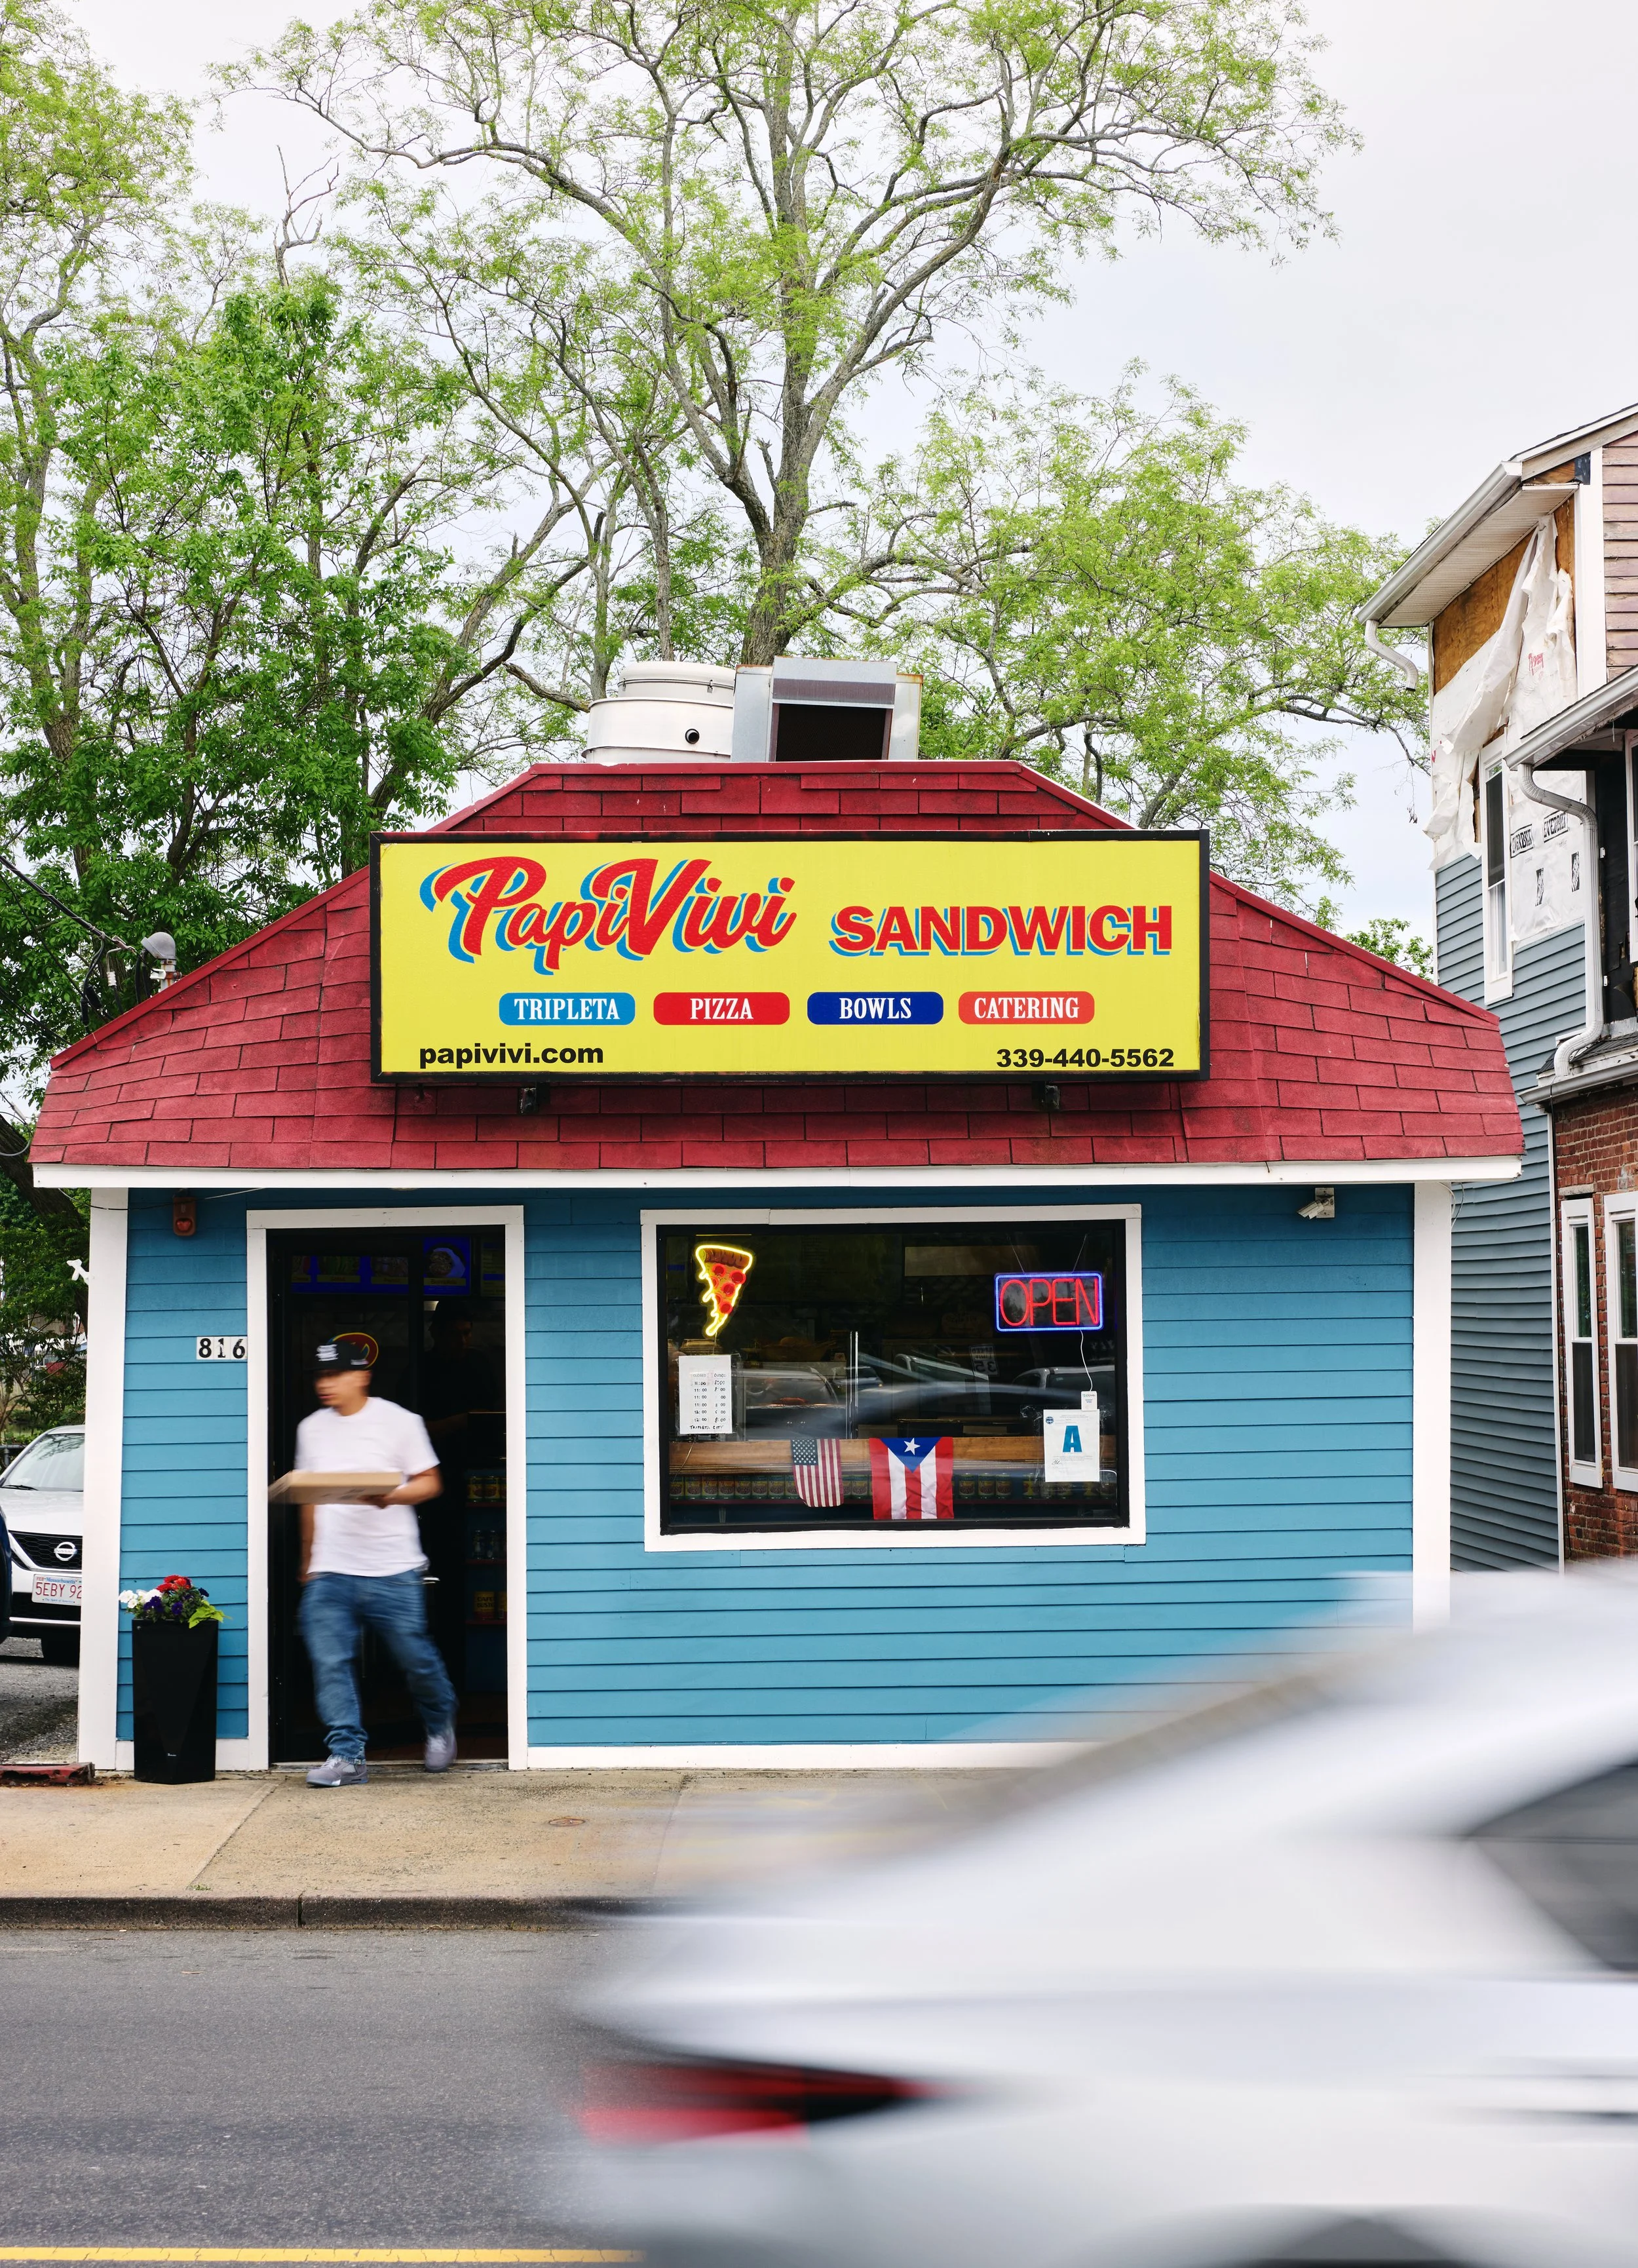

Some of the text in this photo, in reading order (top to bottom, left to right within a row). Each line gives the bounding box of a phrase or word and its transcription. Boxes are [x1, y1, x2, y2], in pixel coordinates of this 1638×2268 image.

[419, 856, 797, 975] PapiVivi
[829, 905, 1173, 957] SANDWICH
[514, 998, 620, 1020] TRIPLETA
[690, 997, 753, 1020] PIZZA
[839, 997, 912, 1020] BOWLS
[974, 997, 1080, 1020] CATERING
[419, 1042, 603, 1069] papivivi.com
[996, 1048, 1174, 1067] 339-440-5562
[1000, 1278, 1099, 1326] OPEN
[199, 1337, 246, 1359] 816
[1063, 1425, 1082, 1452] A
[35, 1582, 65, 1597] 5EBY
